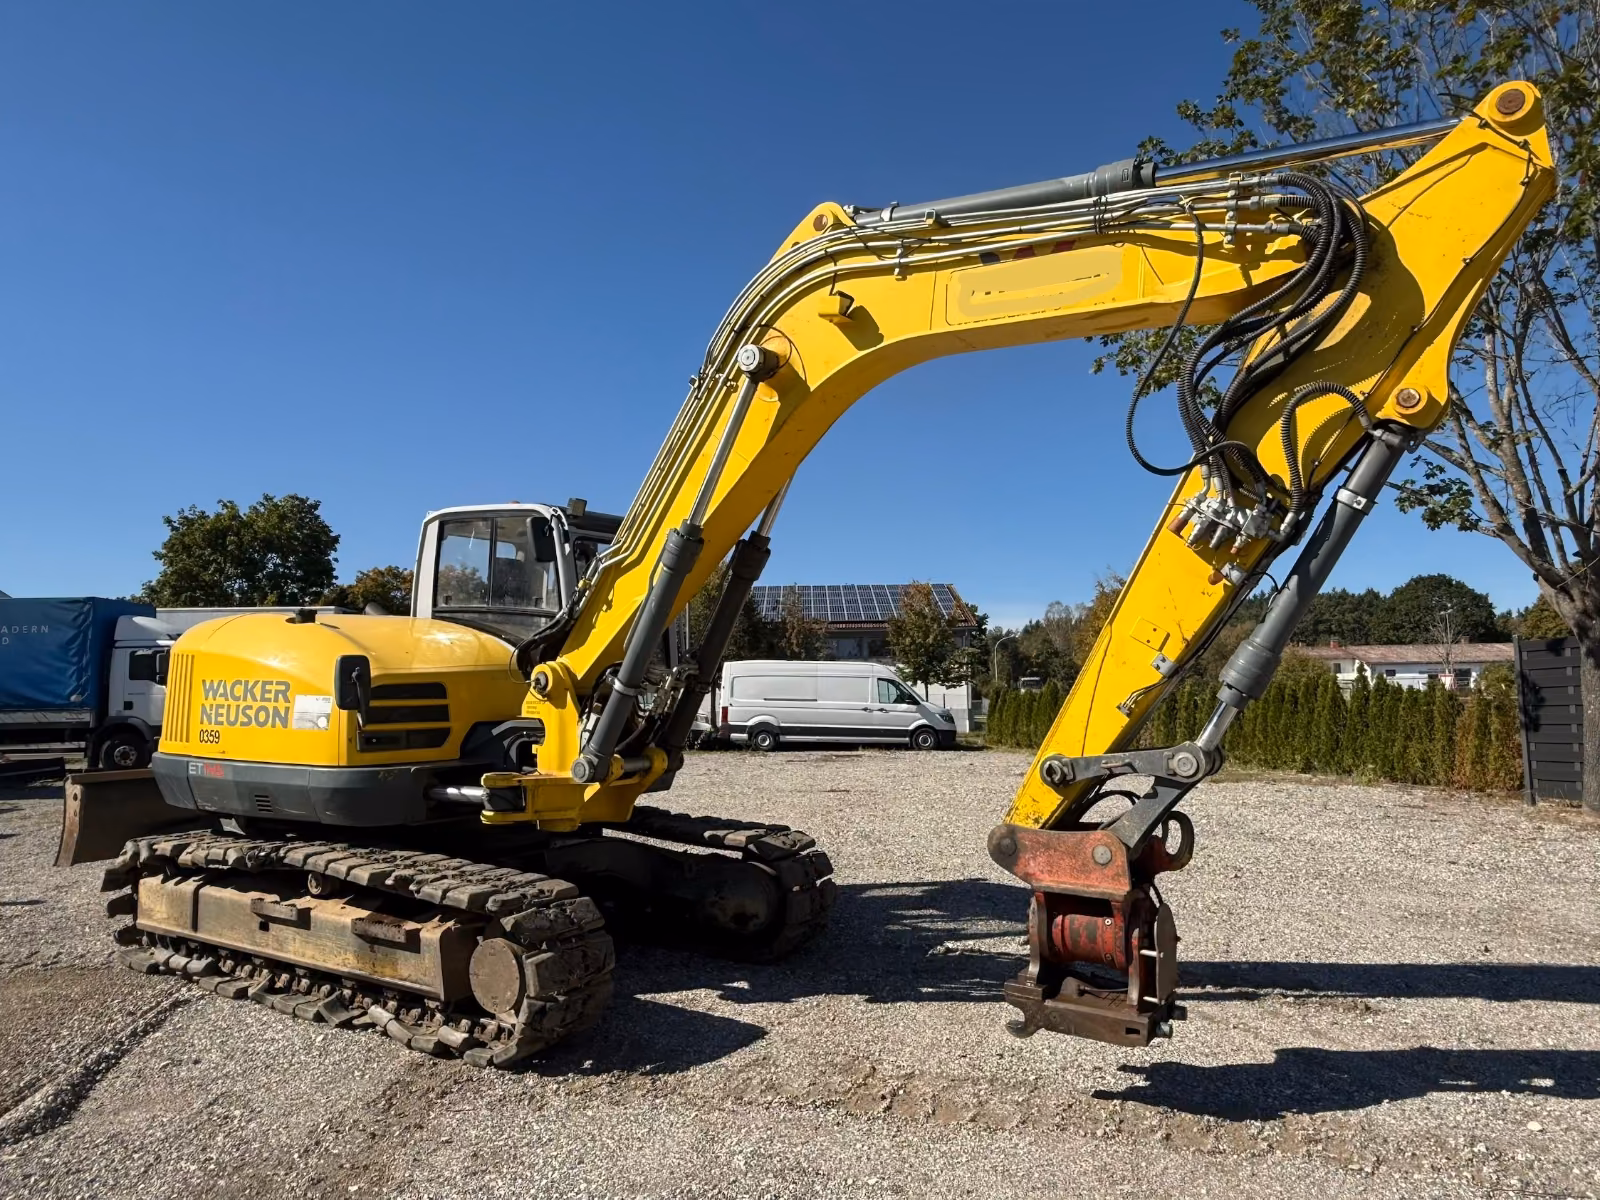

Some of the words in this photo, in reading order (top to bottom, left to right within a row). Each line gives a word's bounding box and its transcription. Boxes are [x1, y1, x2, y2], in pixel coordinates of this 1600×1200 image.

[201, 679, 291, 703] WACKER
[200, 703, 290, 728] NEUSON
[199, 729, 220, 744] 0359
